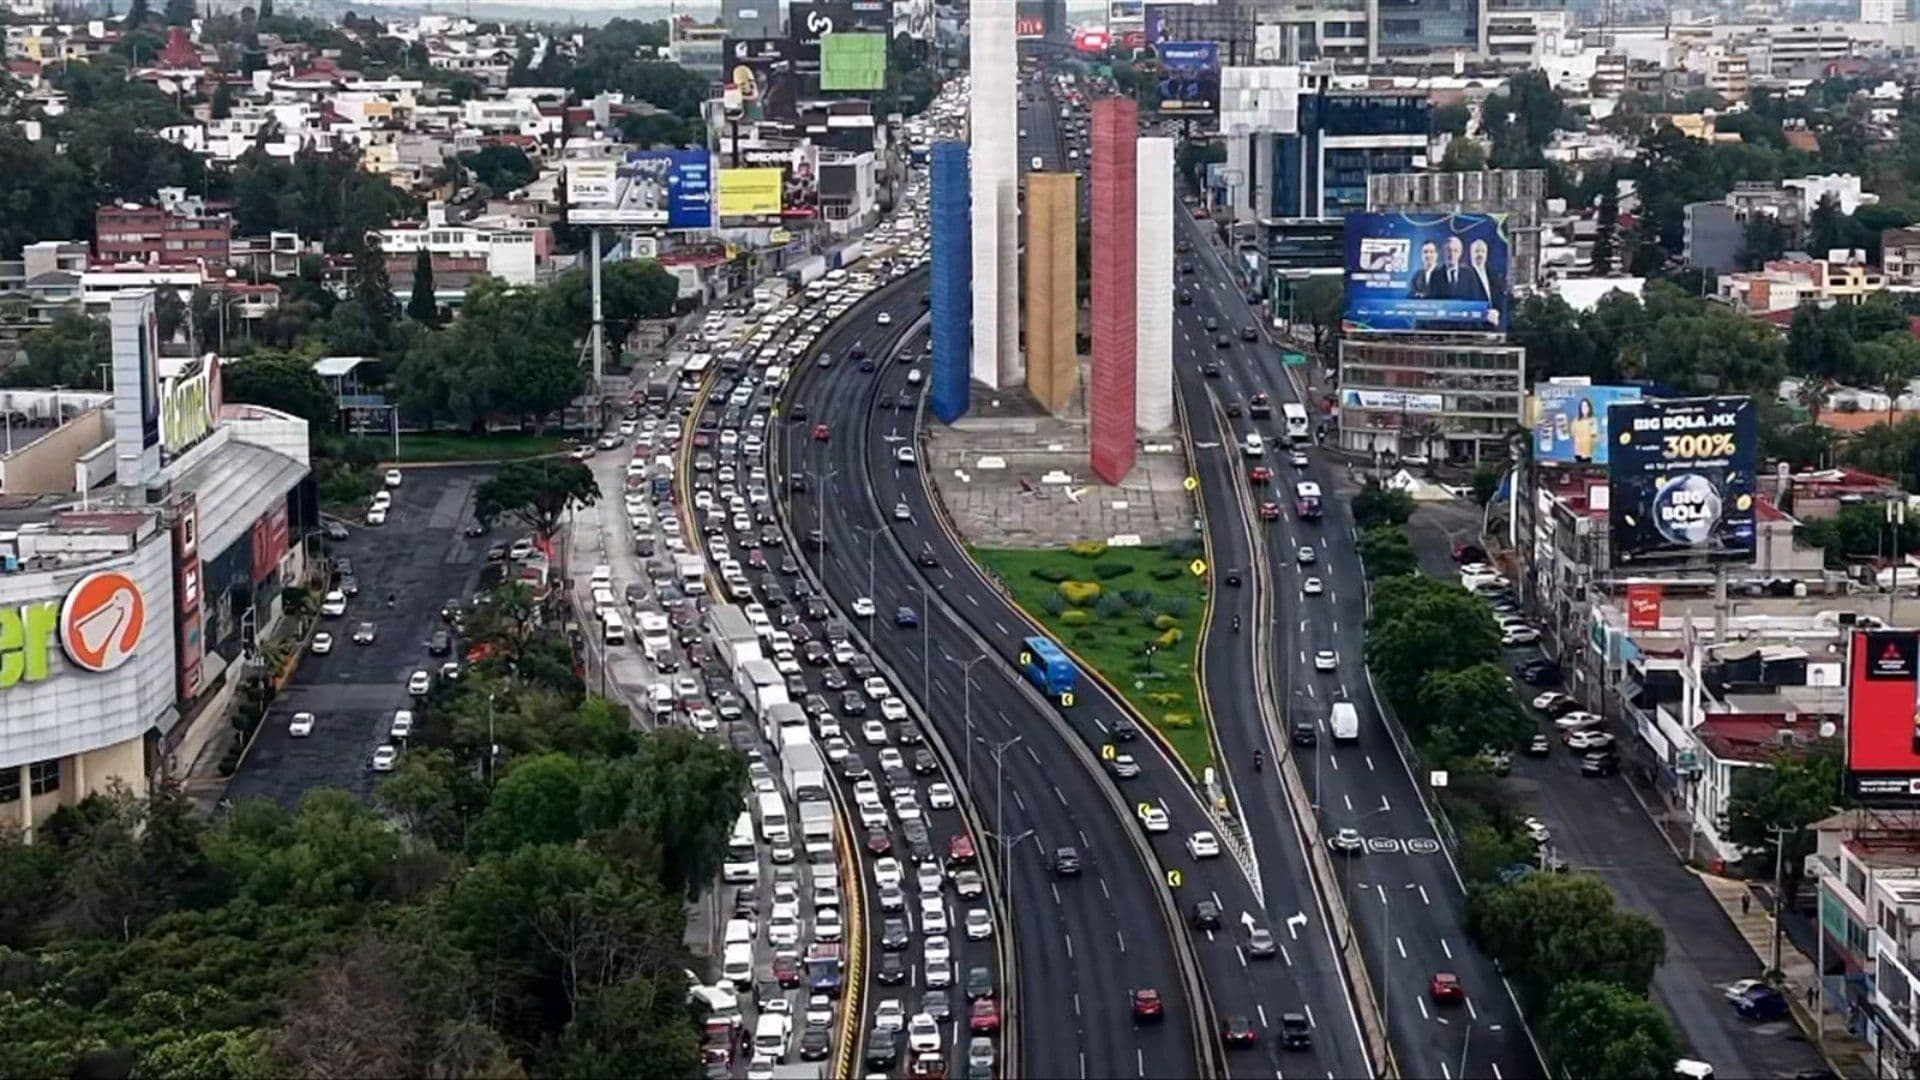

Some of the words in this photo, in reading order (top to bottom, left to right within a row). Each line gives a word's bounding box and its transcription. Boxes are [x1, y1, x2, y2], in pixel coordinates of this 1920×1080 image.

[1633, 417, 1660, 431] BIG
[1662, 433, 1736, 459] 300%
[1672, 490, 1704, 504] BIG
[1661, 504, 1711, 521] BOLA
